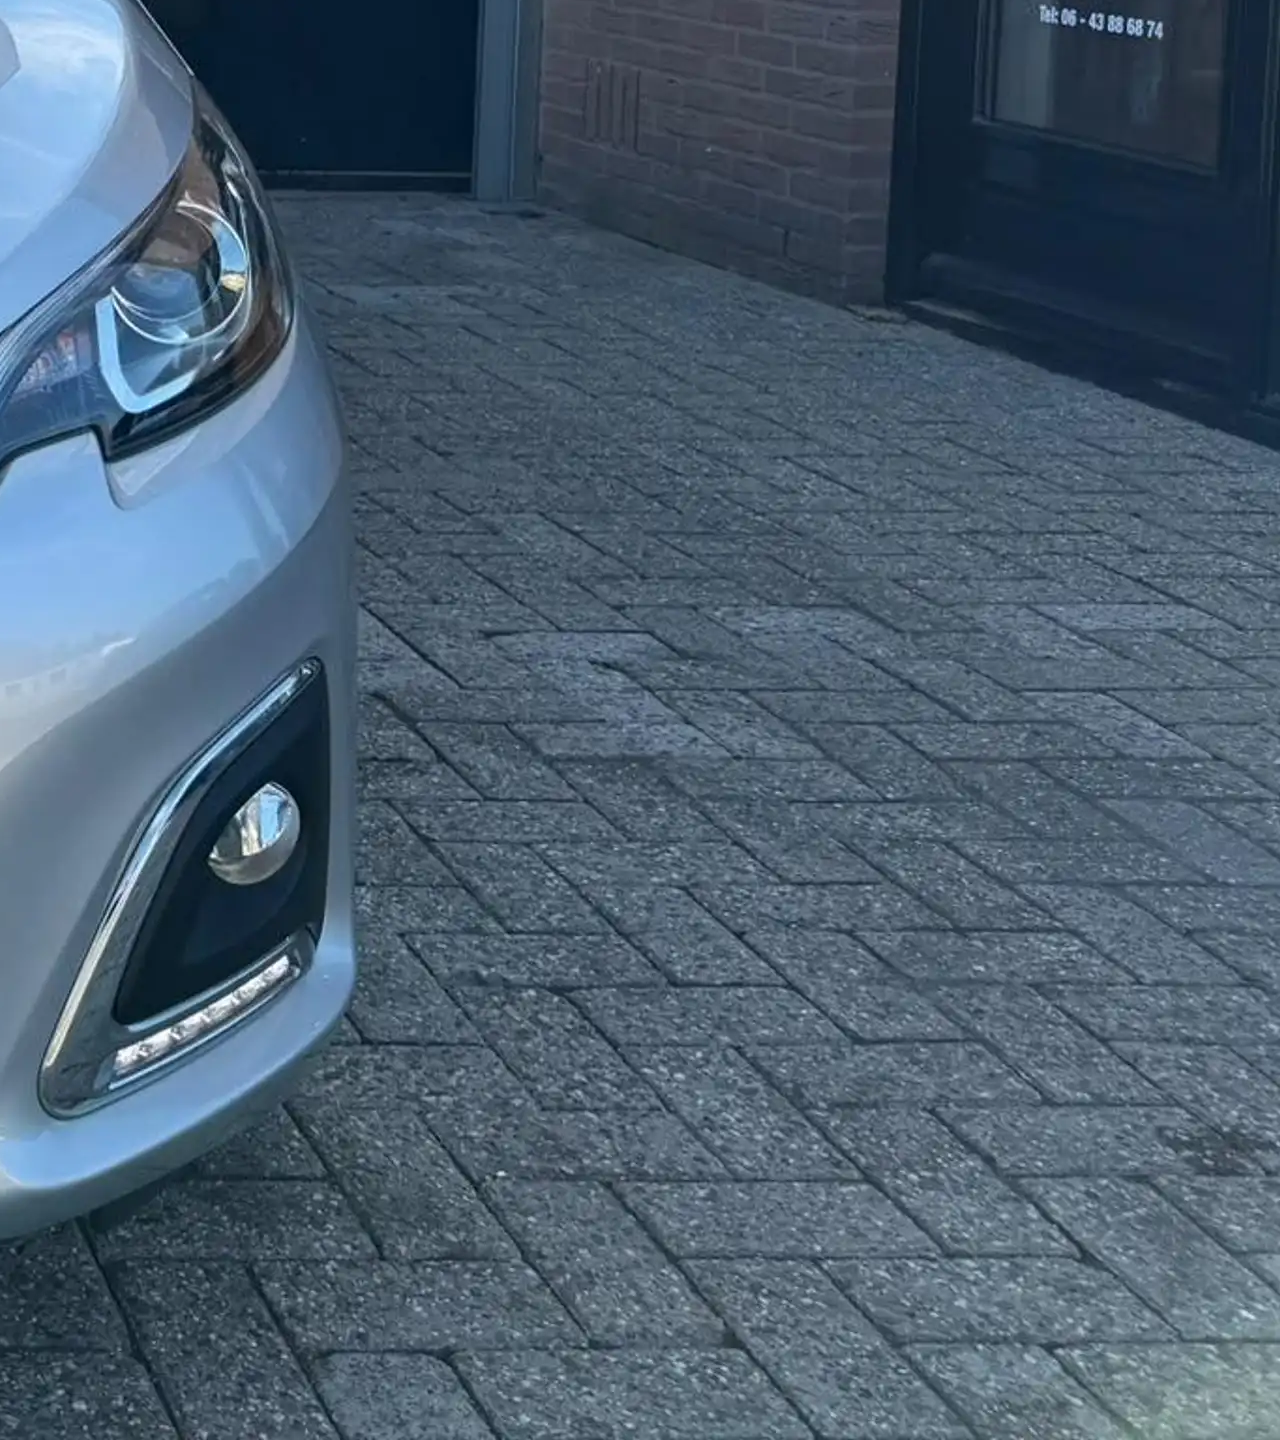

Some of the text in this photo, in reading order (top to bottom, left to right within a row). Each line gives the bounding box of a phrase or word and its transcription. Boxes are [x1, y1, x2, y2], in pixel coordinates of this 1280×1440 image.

[1040, 5, 1058, 24] Tel:
[1061, 9, 1077, 27] 06
[1089, 12, 1105, 31] 43
[1107, 15, 1124, 34] 88
[1126, 17, 1144, 37] 68
[1147, 21, 1164, 40] 74
